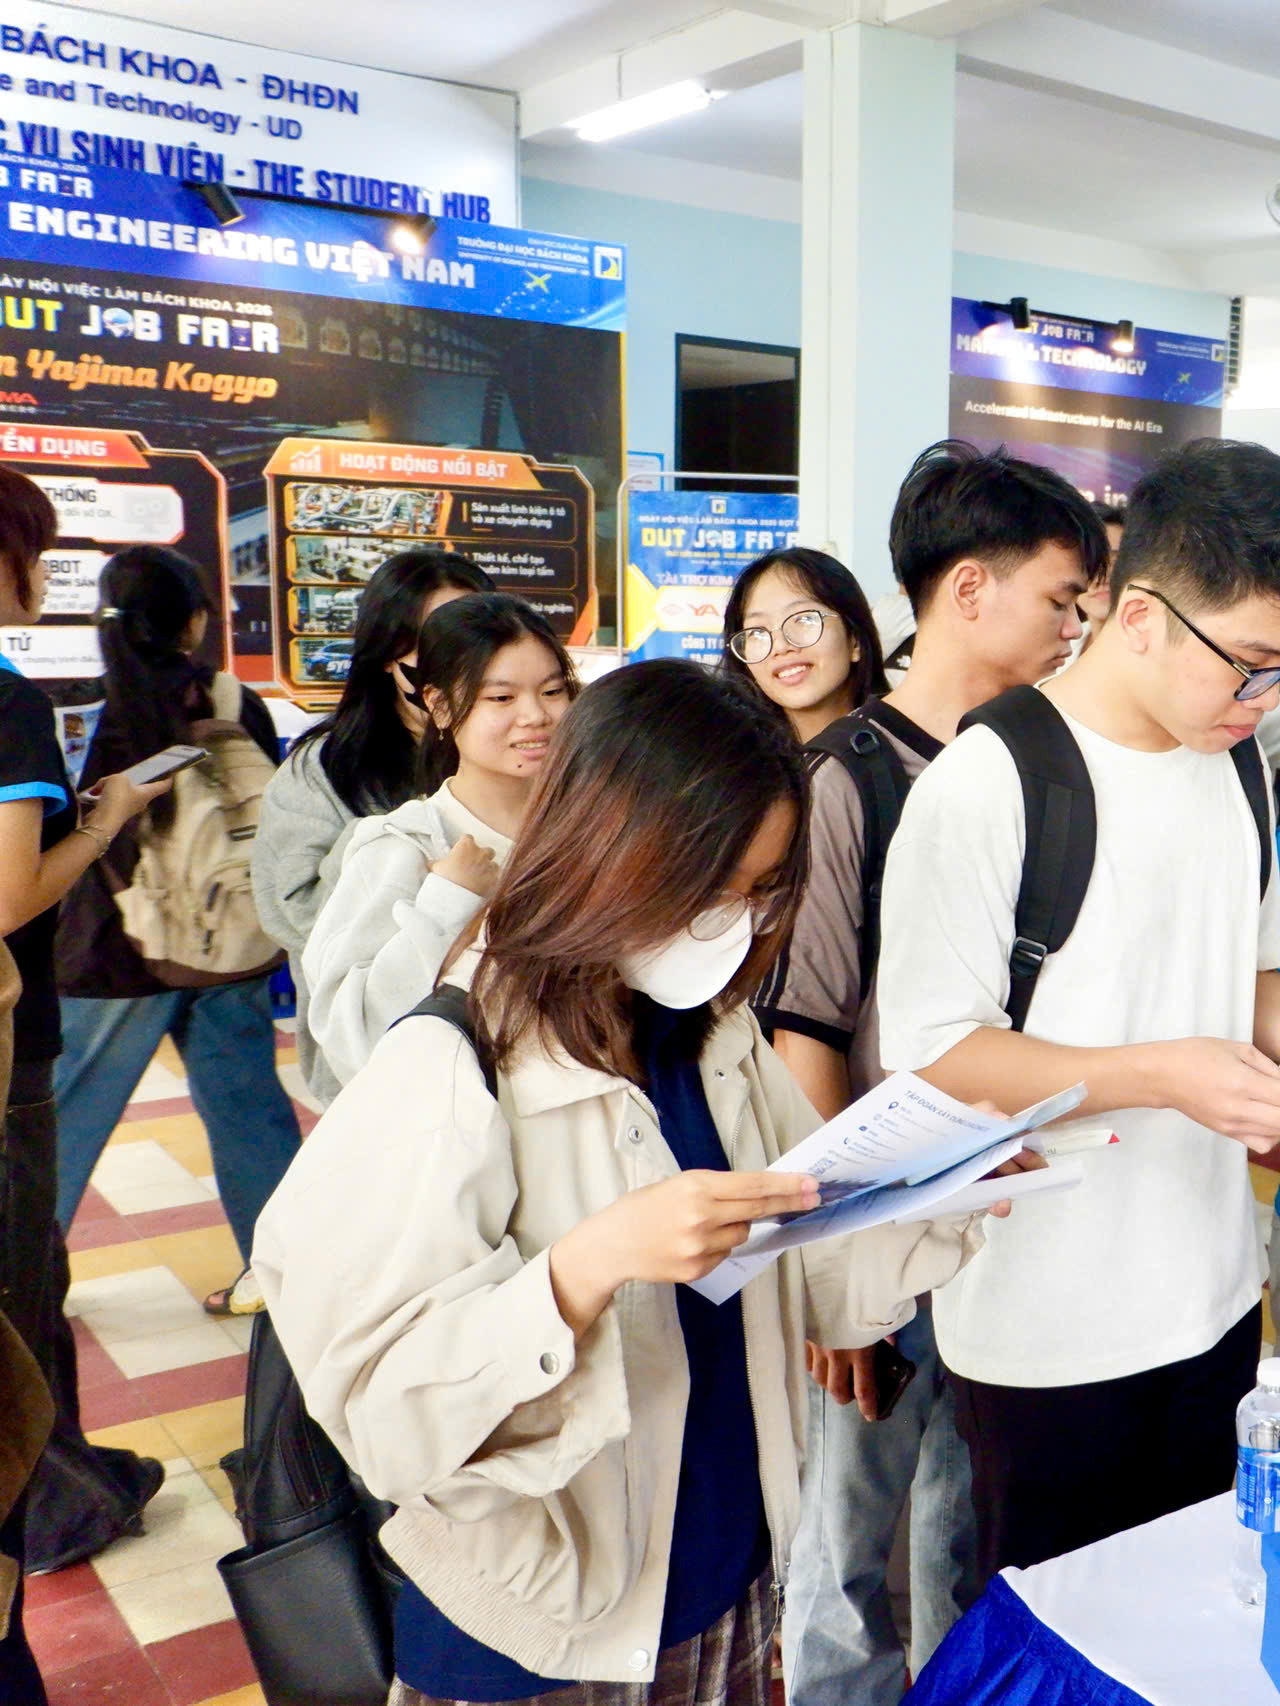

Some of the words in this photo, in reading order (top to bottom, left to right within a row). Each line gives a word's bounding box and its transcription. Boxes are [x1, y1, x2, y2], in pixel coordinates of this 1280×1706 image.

[1, 23, 106, 69] BÁCH
[119, 46, 222, 89] KHOA
[261, 73, 359, 115] ĐHĐN
[25, 76, 75, 101] and
[87, 82, 241, 135] Technology
[267, 115, 302, 140] UD
[71, 129, 146, 172] SINH
[155, 141, 224, 185] VIÊN
[253, 158, 304, 198] THE
[314, 168, 431, 214] STUDENT
[442, 190, 491, 225] HUB
[8, 201, 299, 266] ENGINEERING
[303, 239, 394, 284] VIỆT
[402, 255, 476, 288] NAM
[0, 295, 63, 332] UT
[80, 303, 163, 343] JOB
[28, 279, 59, 295] HỘI
[64, 281, 101, 299] VIỆC
[104, 284, 139, 302] LÀM
[142, 290, 187, 307] BÁCH
[188, 296, 233, 312] KHOA
[26, 349, 157, 390] Yajima
[163, 361, 279, 404] Kogyo
[965, 400, 1028, 419] Accelerated
[1100, 414, 1115, 429] for
[1116, 417, 1132, 431] the
[1146, 420, 1164, 433] Era
[40, 437, 107, 460] DỤNG
[339, 452, 387, 473] HOẠT
[391, 454, 438, 475] ĐỘNG
[442, 455, 472, 475] NỔI
[475, 459, 508, 480] BẬT
[641, 527, 687, 548] DUT
